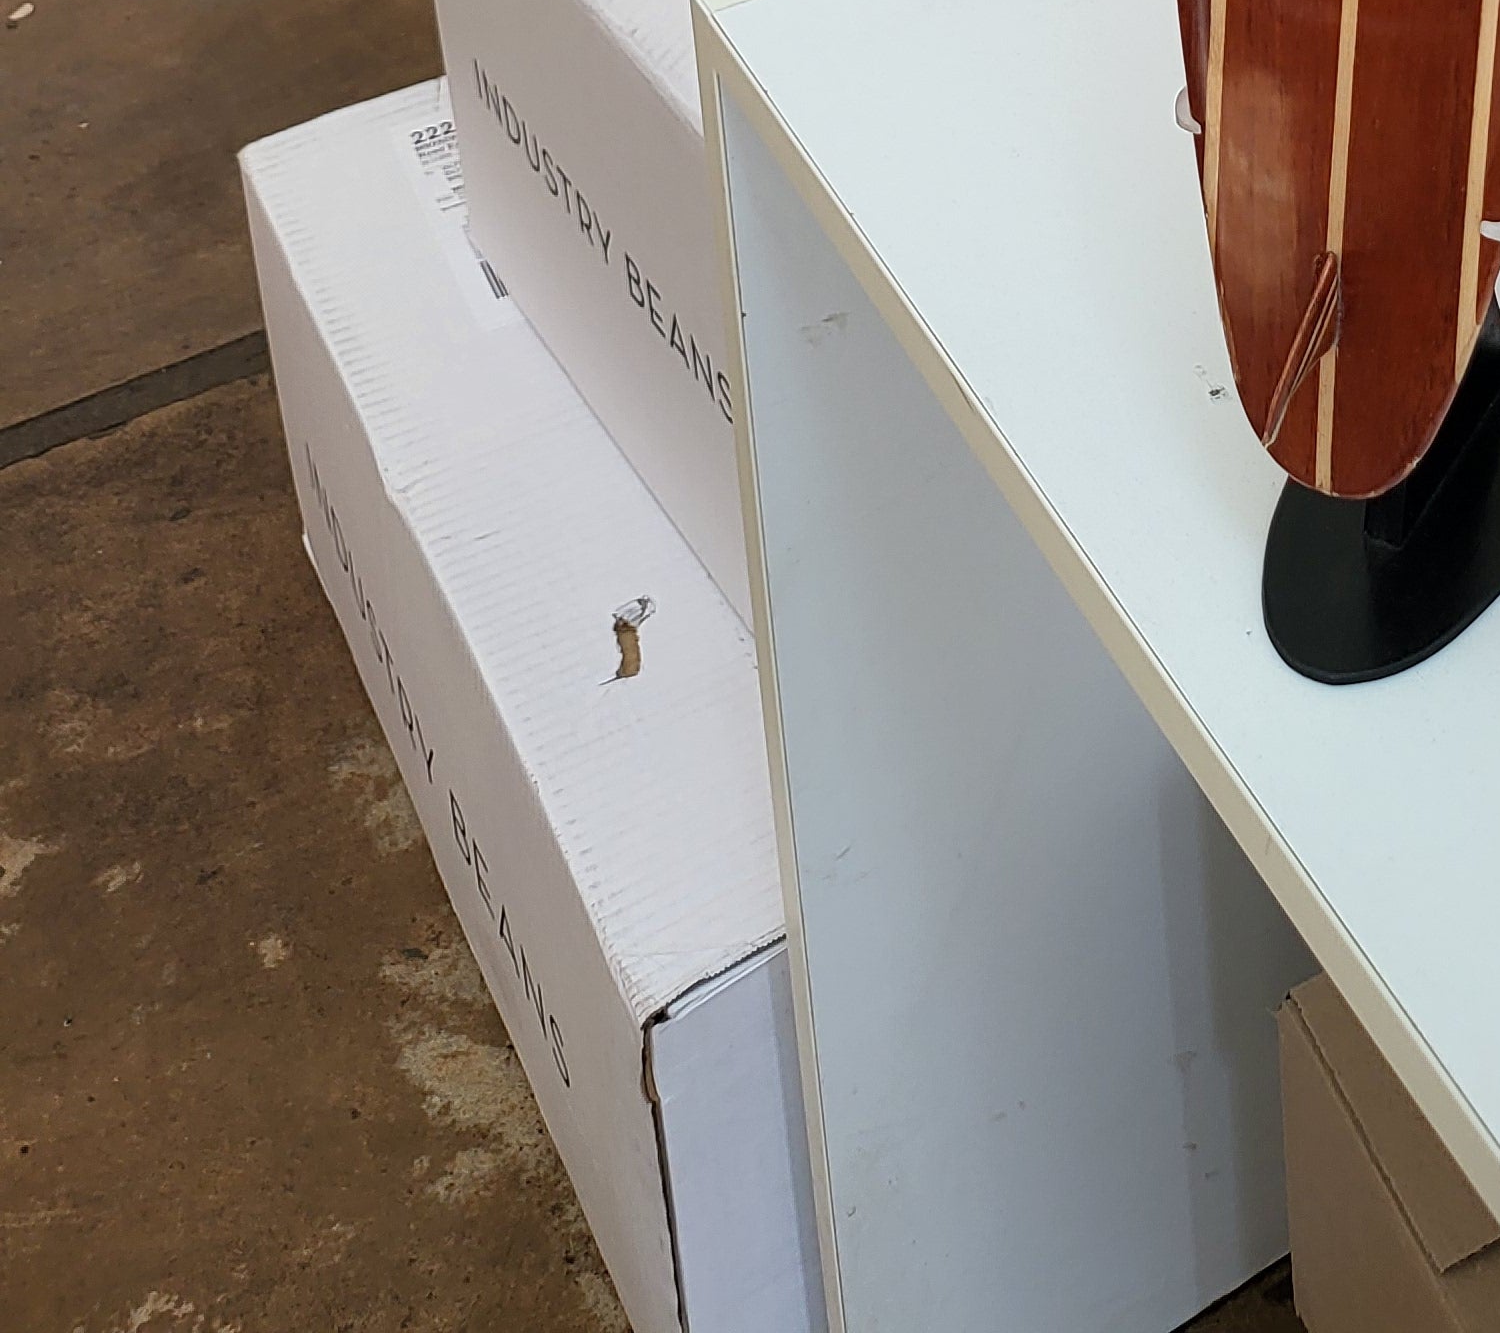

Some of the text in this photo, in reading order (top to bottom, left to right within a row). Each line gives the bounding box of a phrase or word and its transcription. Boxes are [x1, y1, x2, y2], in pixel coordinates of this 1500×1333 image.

[474, 58, 733, 424] INDUSTRY BEANS
[305, 441, 571, 1088] INDUSTRY BEANS
